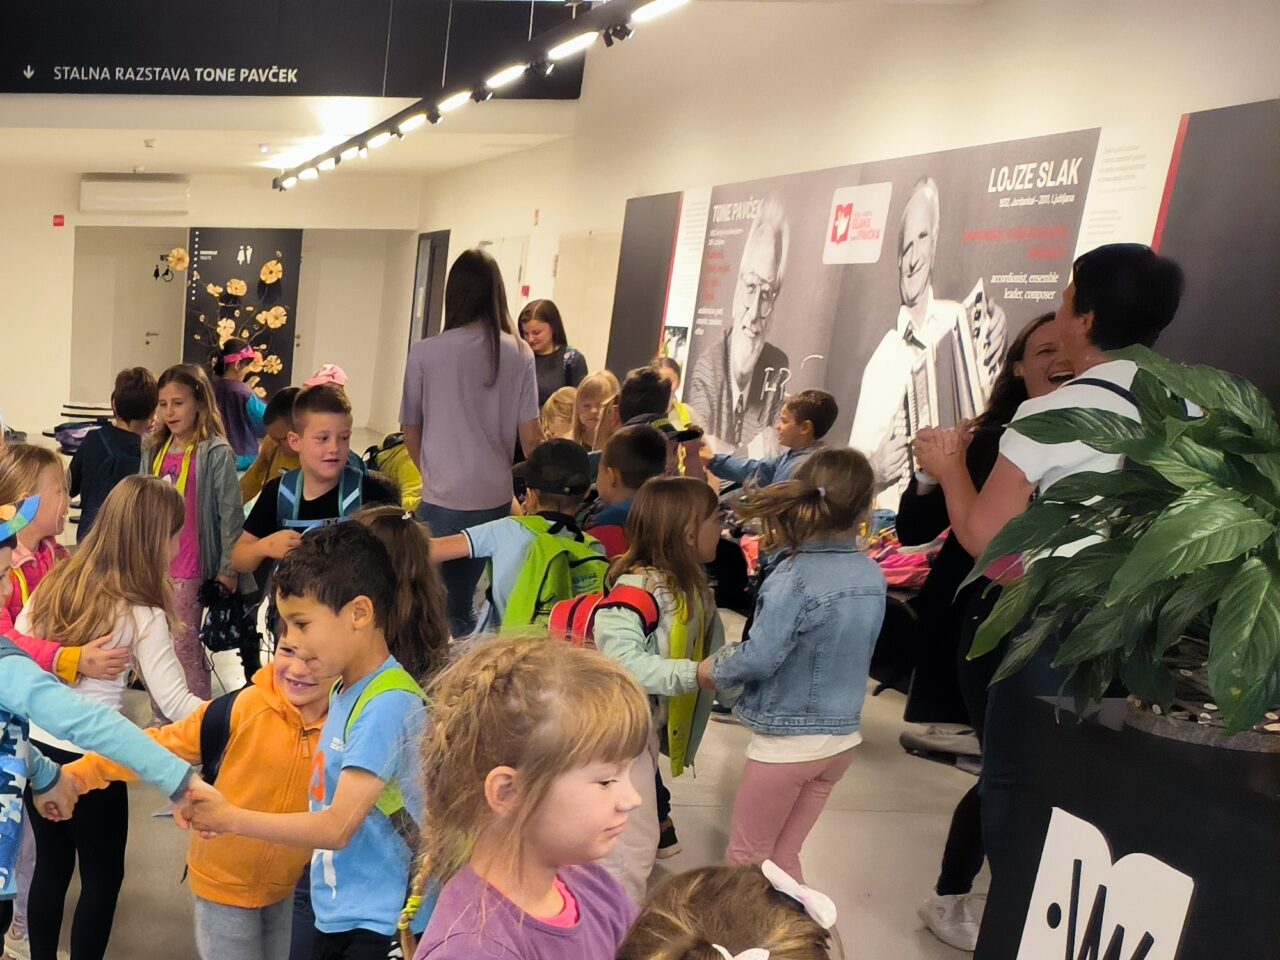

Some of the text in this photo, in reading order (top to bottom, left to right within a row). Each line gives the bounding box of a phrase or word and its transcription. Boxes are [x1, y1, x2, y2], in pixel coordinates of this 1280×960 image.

[53, 64, 298, 83] STALNA RAZSTAVA TONE PAVČEK
[987, 162, 1038, 193] LOJZE
[1036, 157, 1084, 189] SLAK
